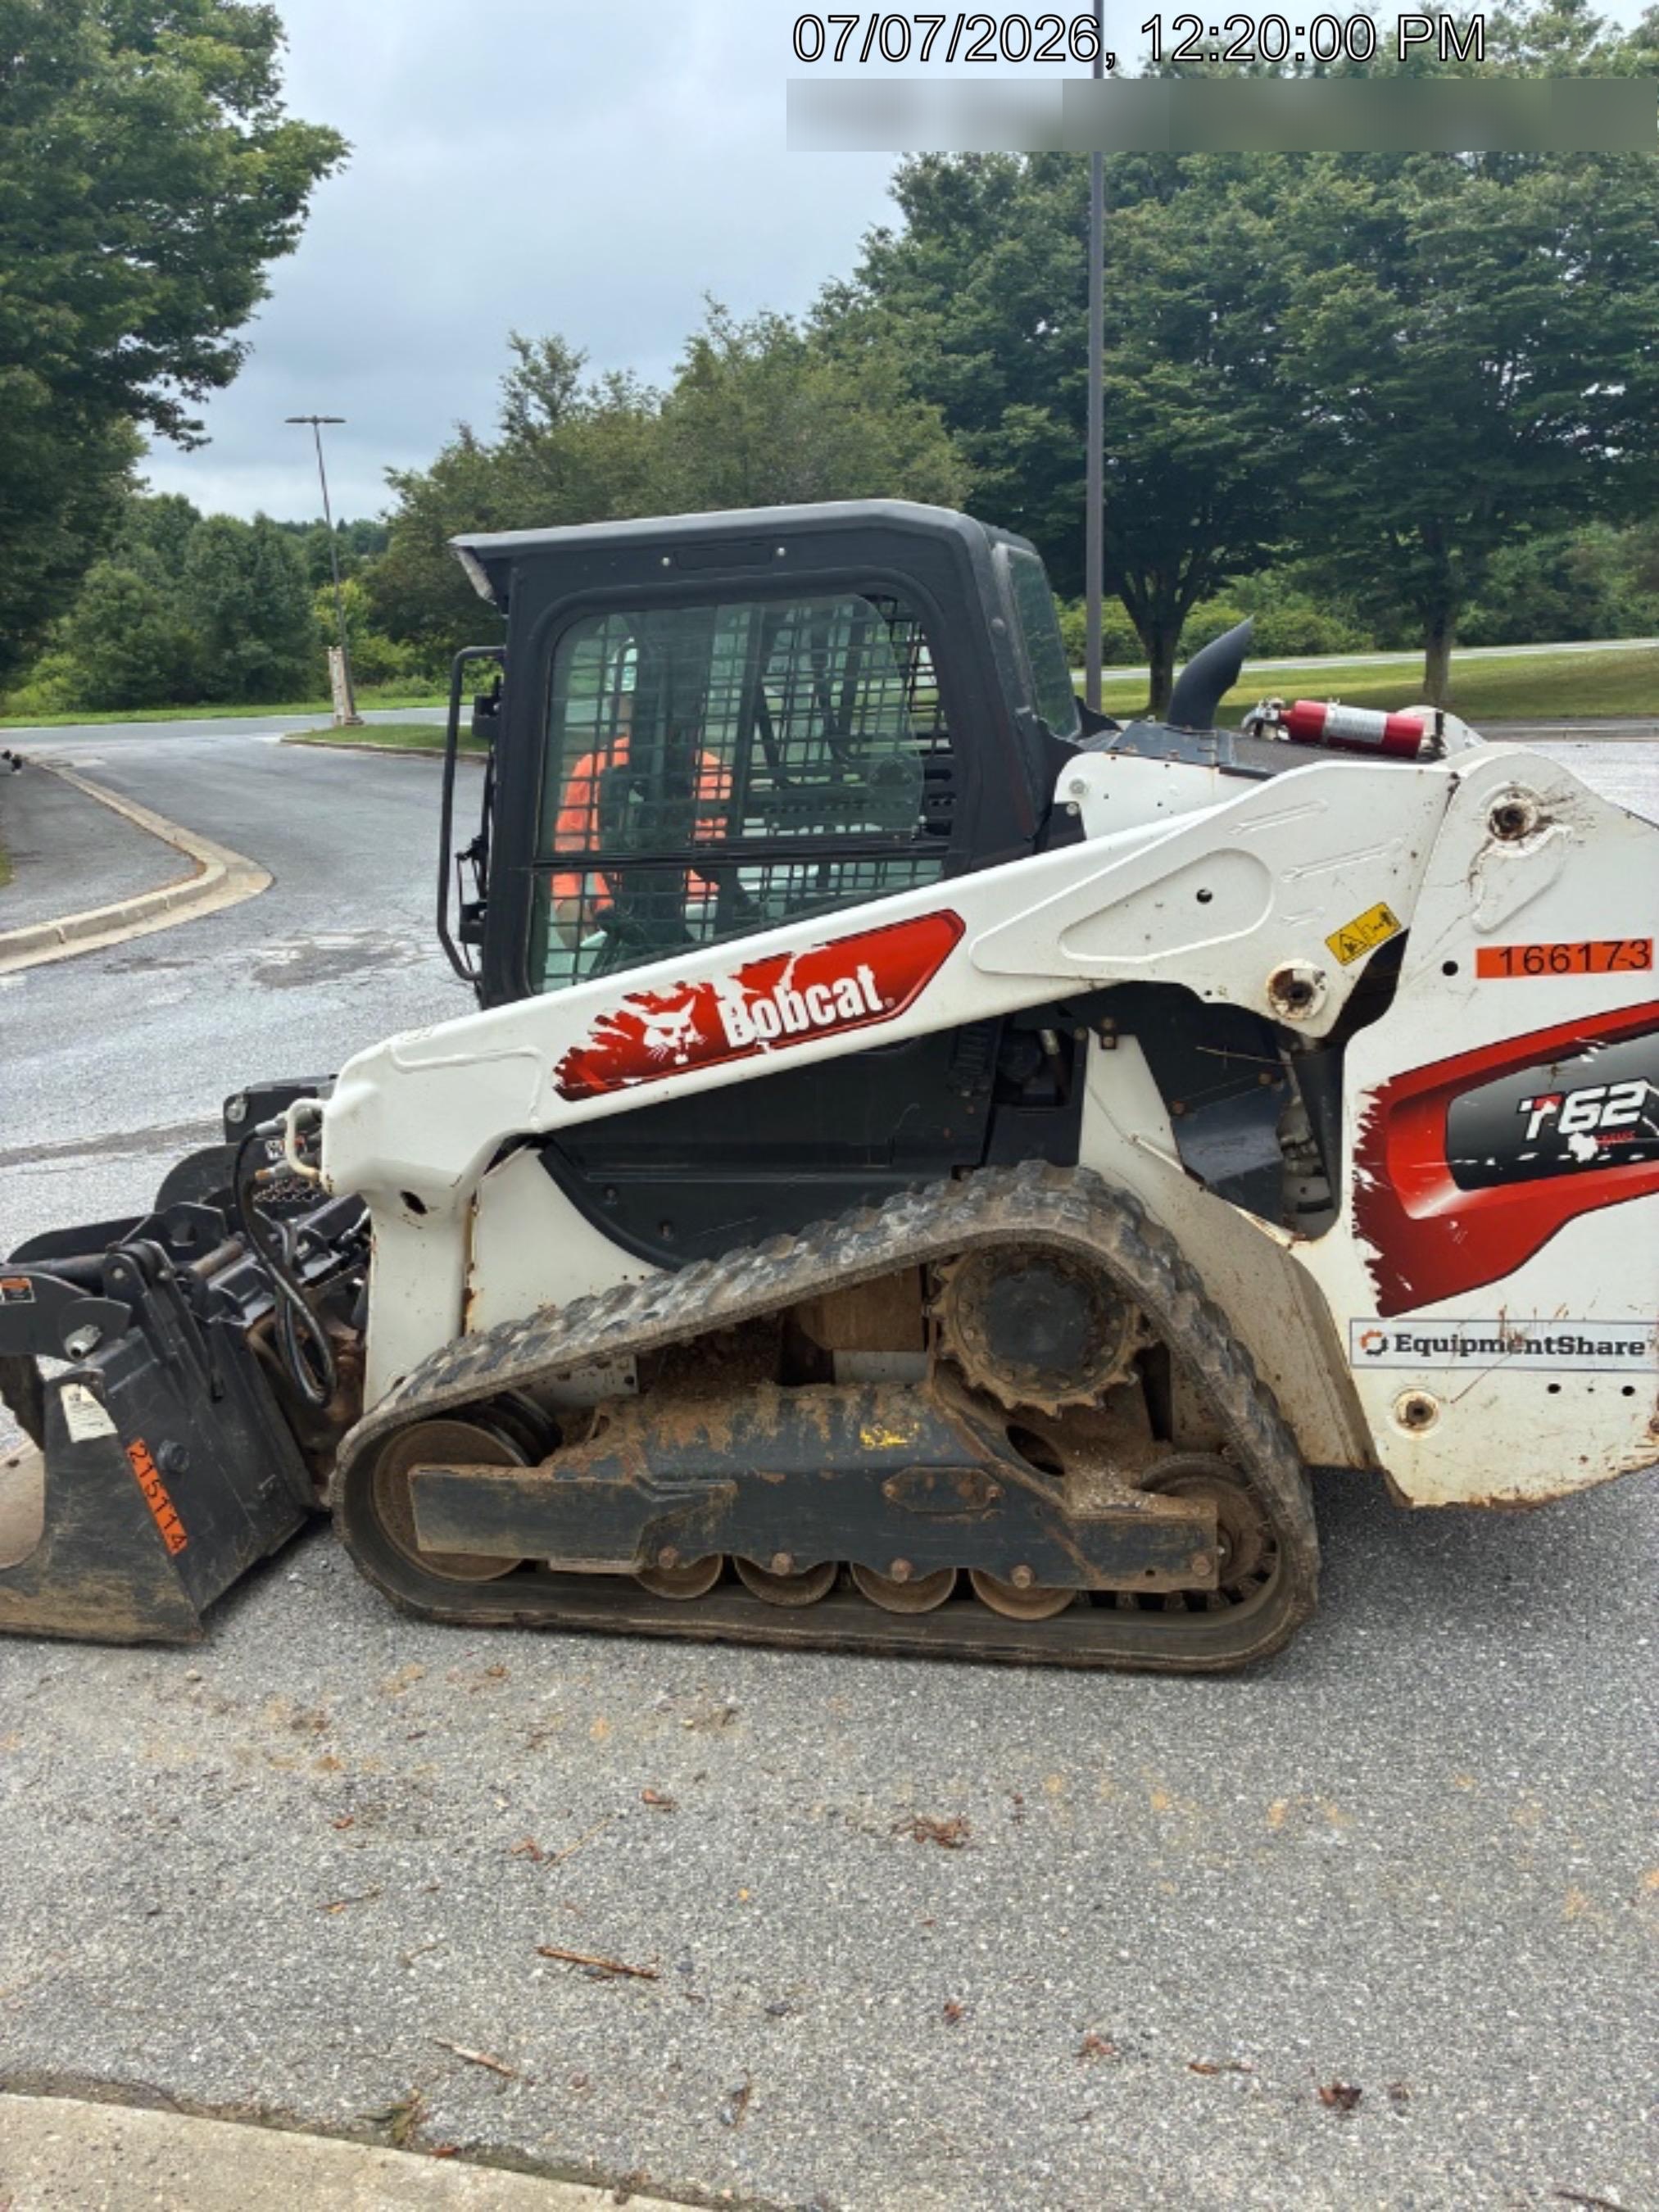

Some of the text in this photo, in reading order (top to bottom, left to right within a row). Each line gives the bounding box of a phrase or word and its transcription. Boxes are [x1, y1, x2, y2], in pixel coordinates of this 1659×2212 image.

[1499, 939, 1651, 976] 166173
[716, 964, 884, 1048] Bobcat
[1519, 1078, 1648, 1141] T62
[1394, 1334, 1646, 1357] EquipmentShare
[129, 1442, 188, 1549] 215114
